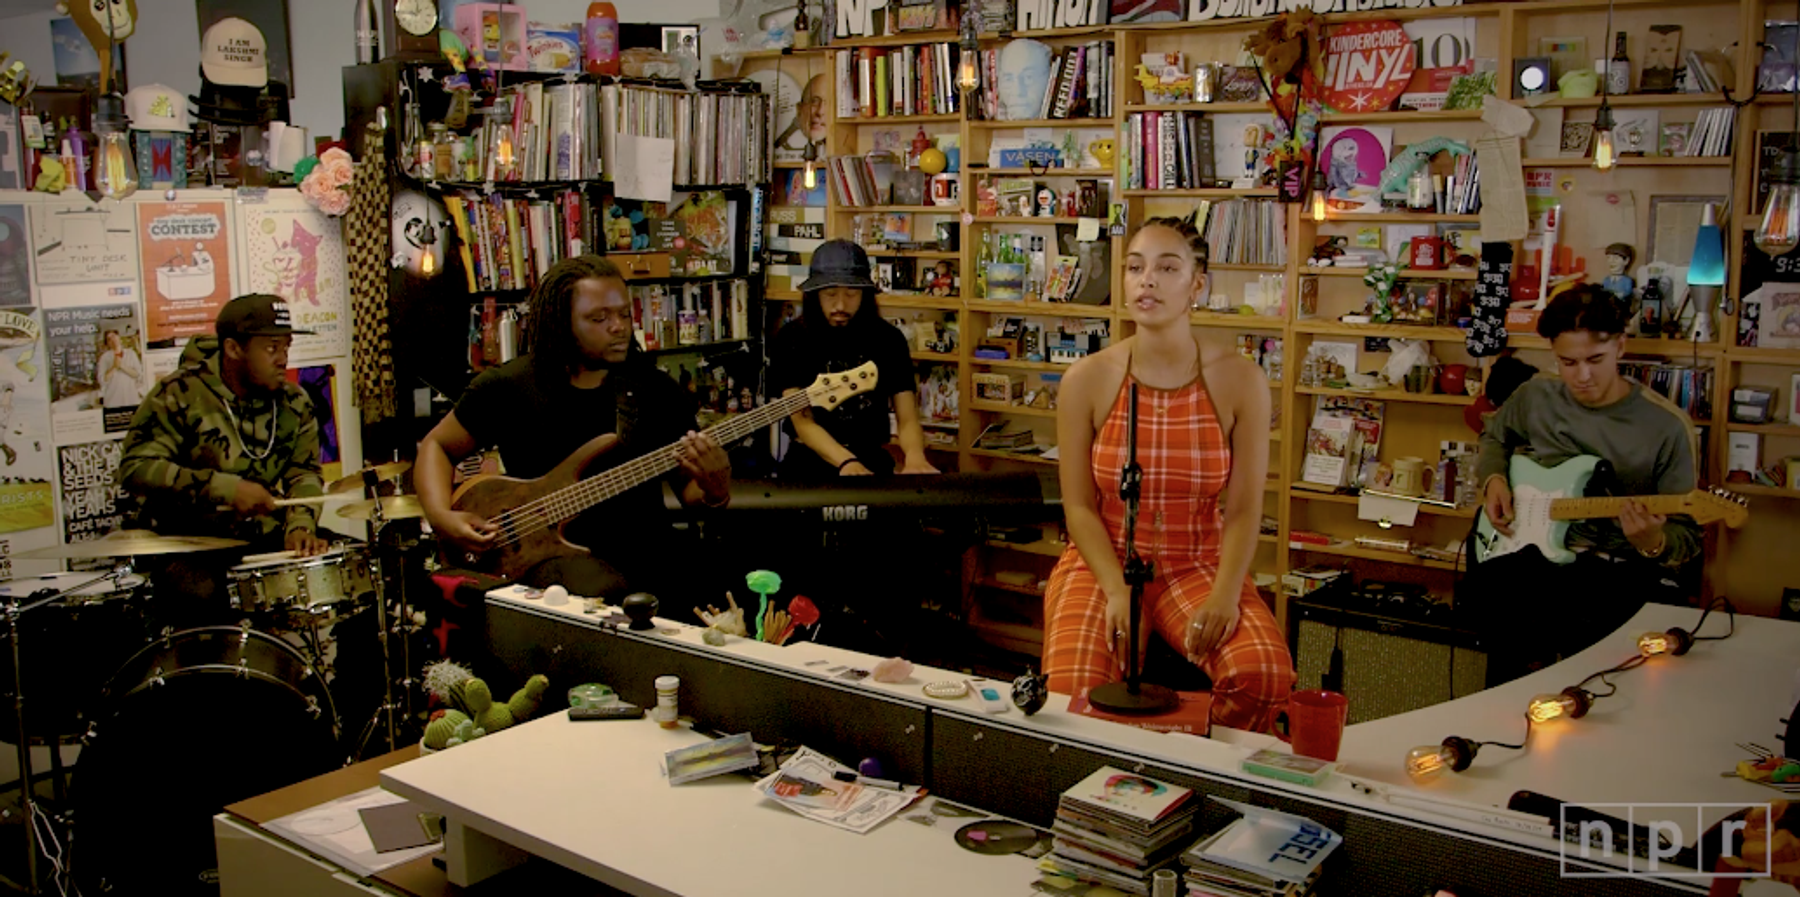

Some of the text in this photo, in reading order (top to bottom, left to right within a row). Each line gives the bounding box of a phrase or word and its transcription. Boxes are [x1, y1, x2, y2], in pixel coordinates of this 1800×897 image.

[235, 39, 250, 47] AM
[1330, 29, 1402, 52] KINDERCORE
[217, 45, 259, 56] LAKSHMI
[1284, 166, 1300, 197] VIP
[151, 223, 217, 236] CONTEST
[48, 307, 131, 322] NPR Music needs
[5, 313, 36, 333] LOVE
[50, 323, 98, 337] your help.
[62, 445, 97, 462] NICK
[76, 461, 103, 474] THE
[64, 472, 114, 490] SEEDS
[65, 487, 106, 505] YEAH
[65, 500, 115, 519] YEAHS
[822, 505, 868, 521] KORG
